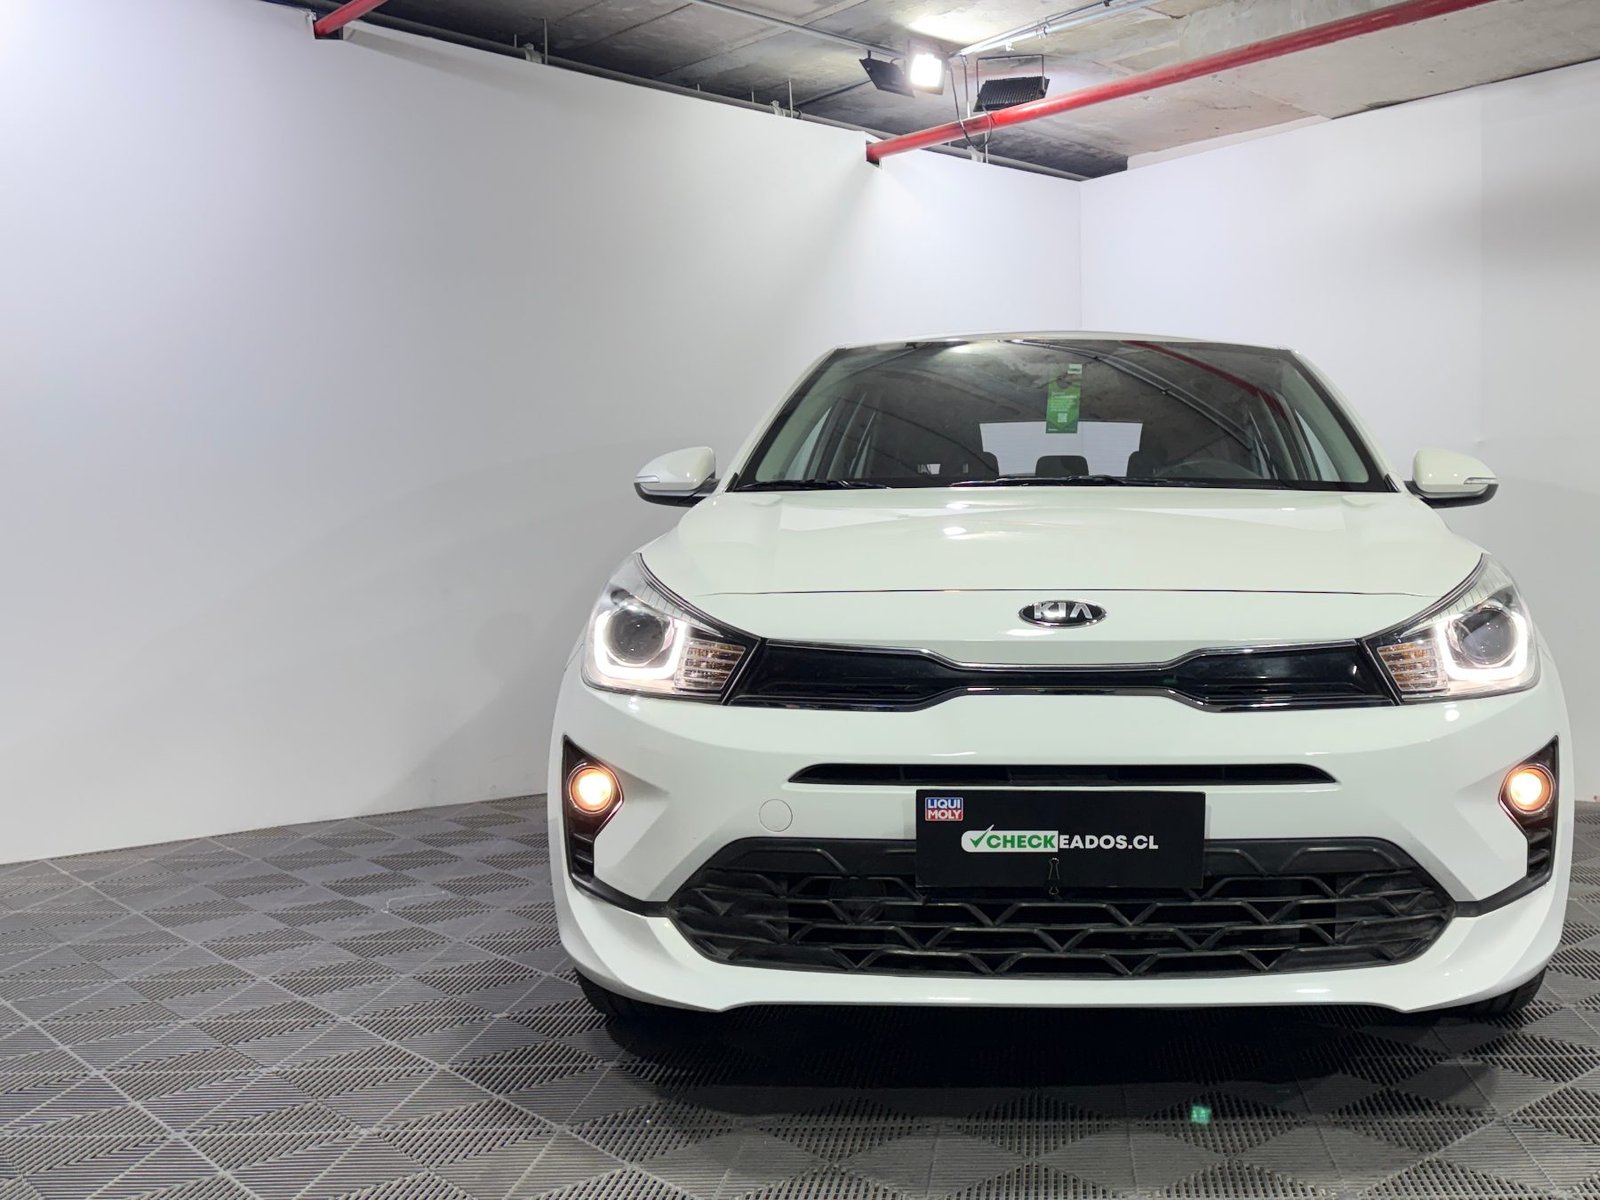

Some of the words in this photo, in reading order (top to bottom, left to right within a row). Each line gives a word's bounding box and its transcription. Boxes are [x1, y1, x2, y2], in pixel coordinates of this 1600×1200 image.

[1033, 602, 1093, 619] KIA
[927, 799, 961, 809] LIQUI
[928, 809, 962, 820] MOLY
[986, 834, 1159, 850] CHECKEADOS.CL
